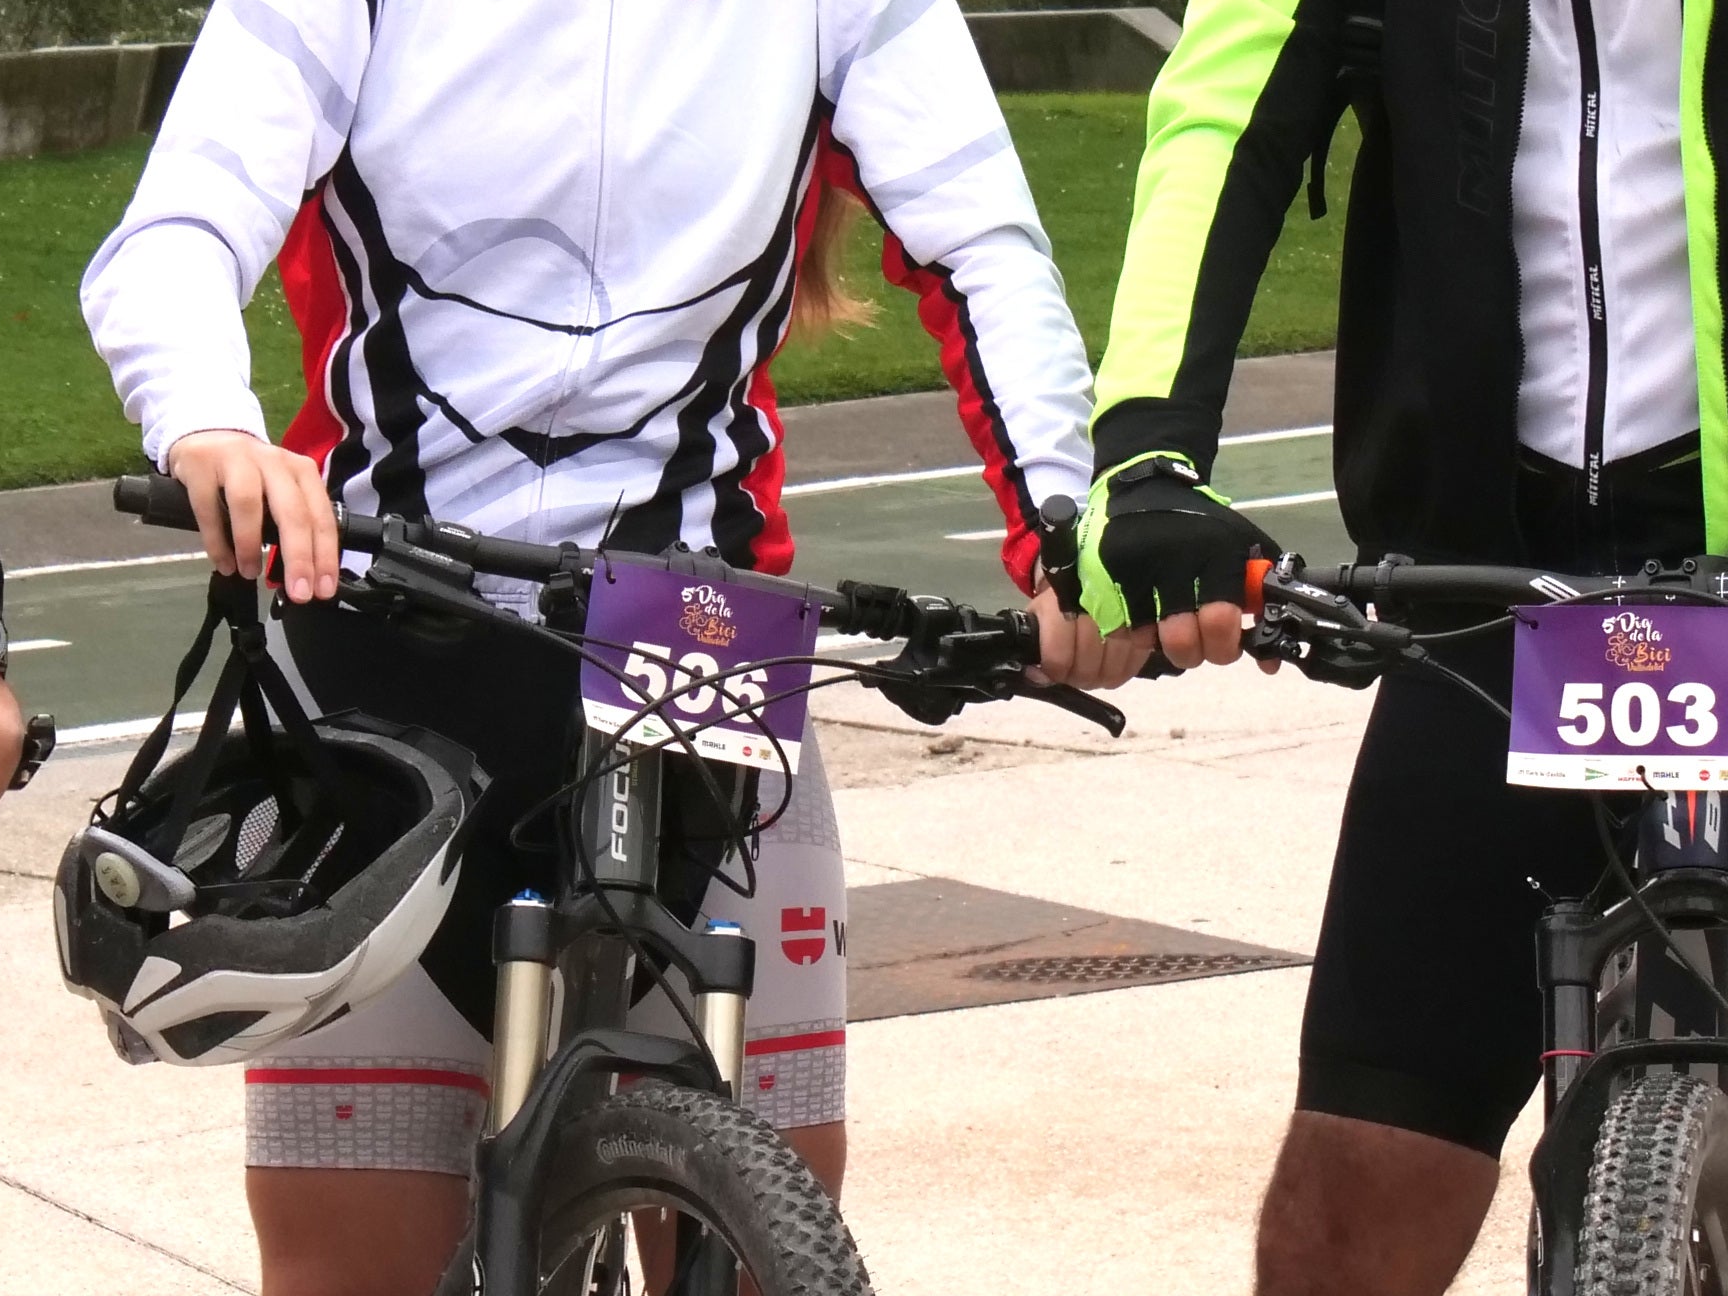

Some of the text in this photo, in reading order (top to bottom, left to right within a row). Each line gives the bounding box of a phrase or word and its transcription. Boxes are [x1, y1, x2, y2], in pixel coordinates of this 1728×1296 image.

[1295, 583, 1328, 598] XT
[1634, 642, 1672, 664] Bici
[620, 641, 768, 724] 506
[1556, 681, 1719, 747] 503
[1652, 770, 1680, 780] MAHLE
